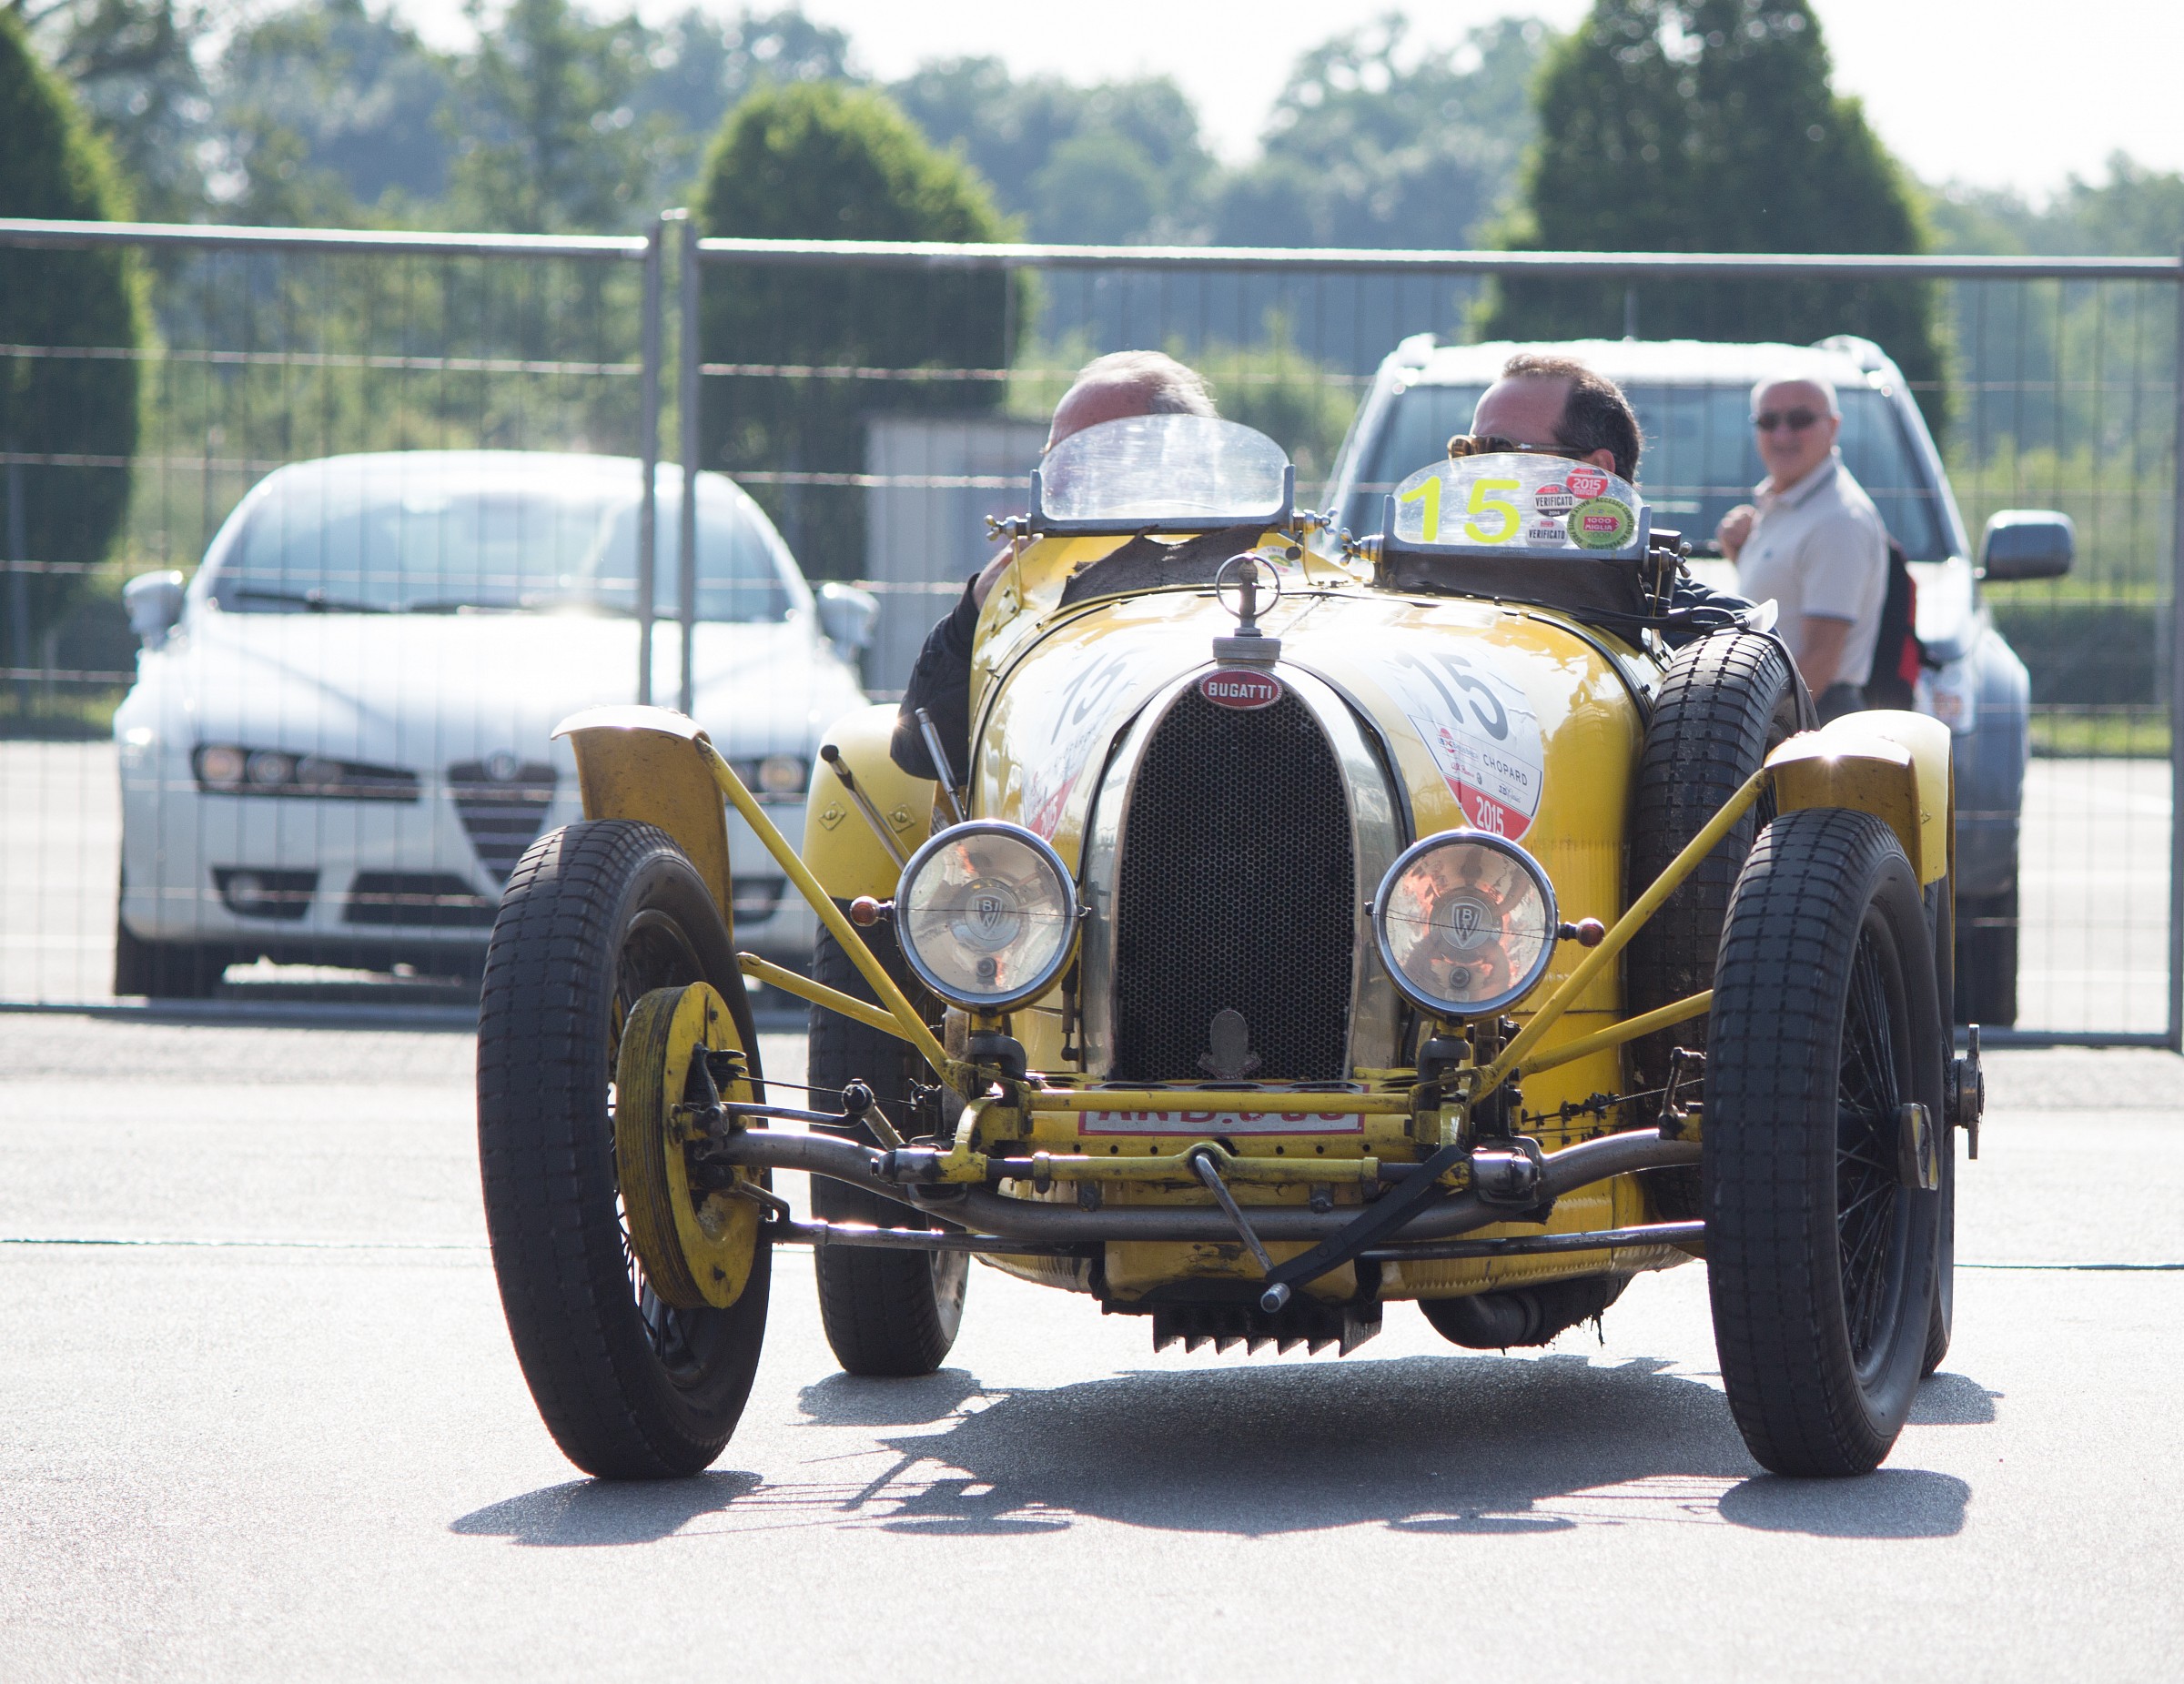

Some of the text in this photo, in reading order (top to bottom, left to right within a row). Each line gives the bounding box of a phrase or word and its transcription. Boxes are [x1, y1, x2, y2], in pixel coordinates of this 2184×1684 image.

[1572, 478, 1602, 490] 2015
[1400, 475, 1521, 543] 15
[1535, 496, 1572, 507] VERIFICATO
[1529, 529, 1565, 539] VERIFICATO
[1208, 681, 1273, 700] BUGATTI
[1394, 650, 1508, 741] 15
[1482, 753, 1528, 786] CHOPARD
[1476, 795, 1504, 836] 2015
